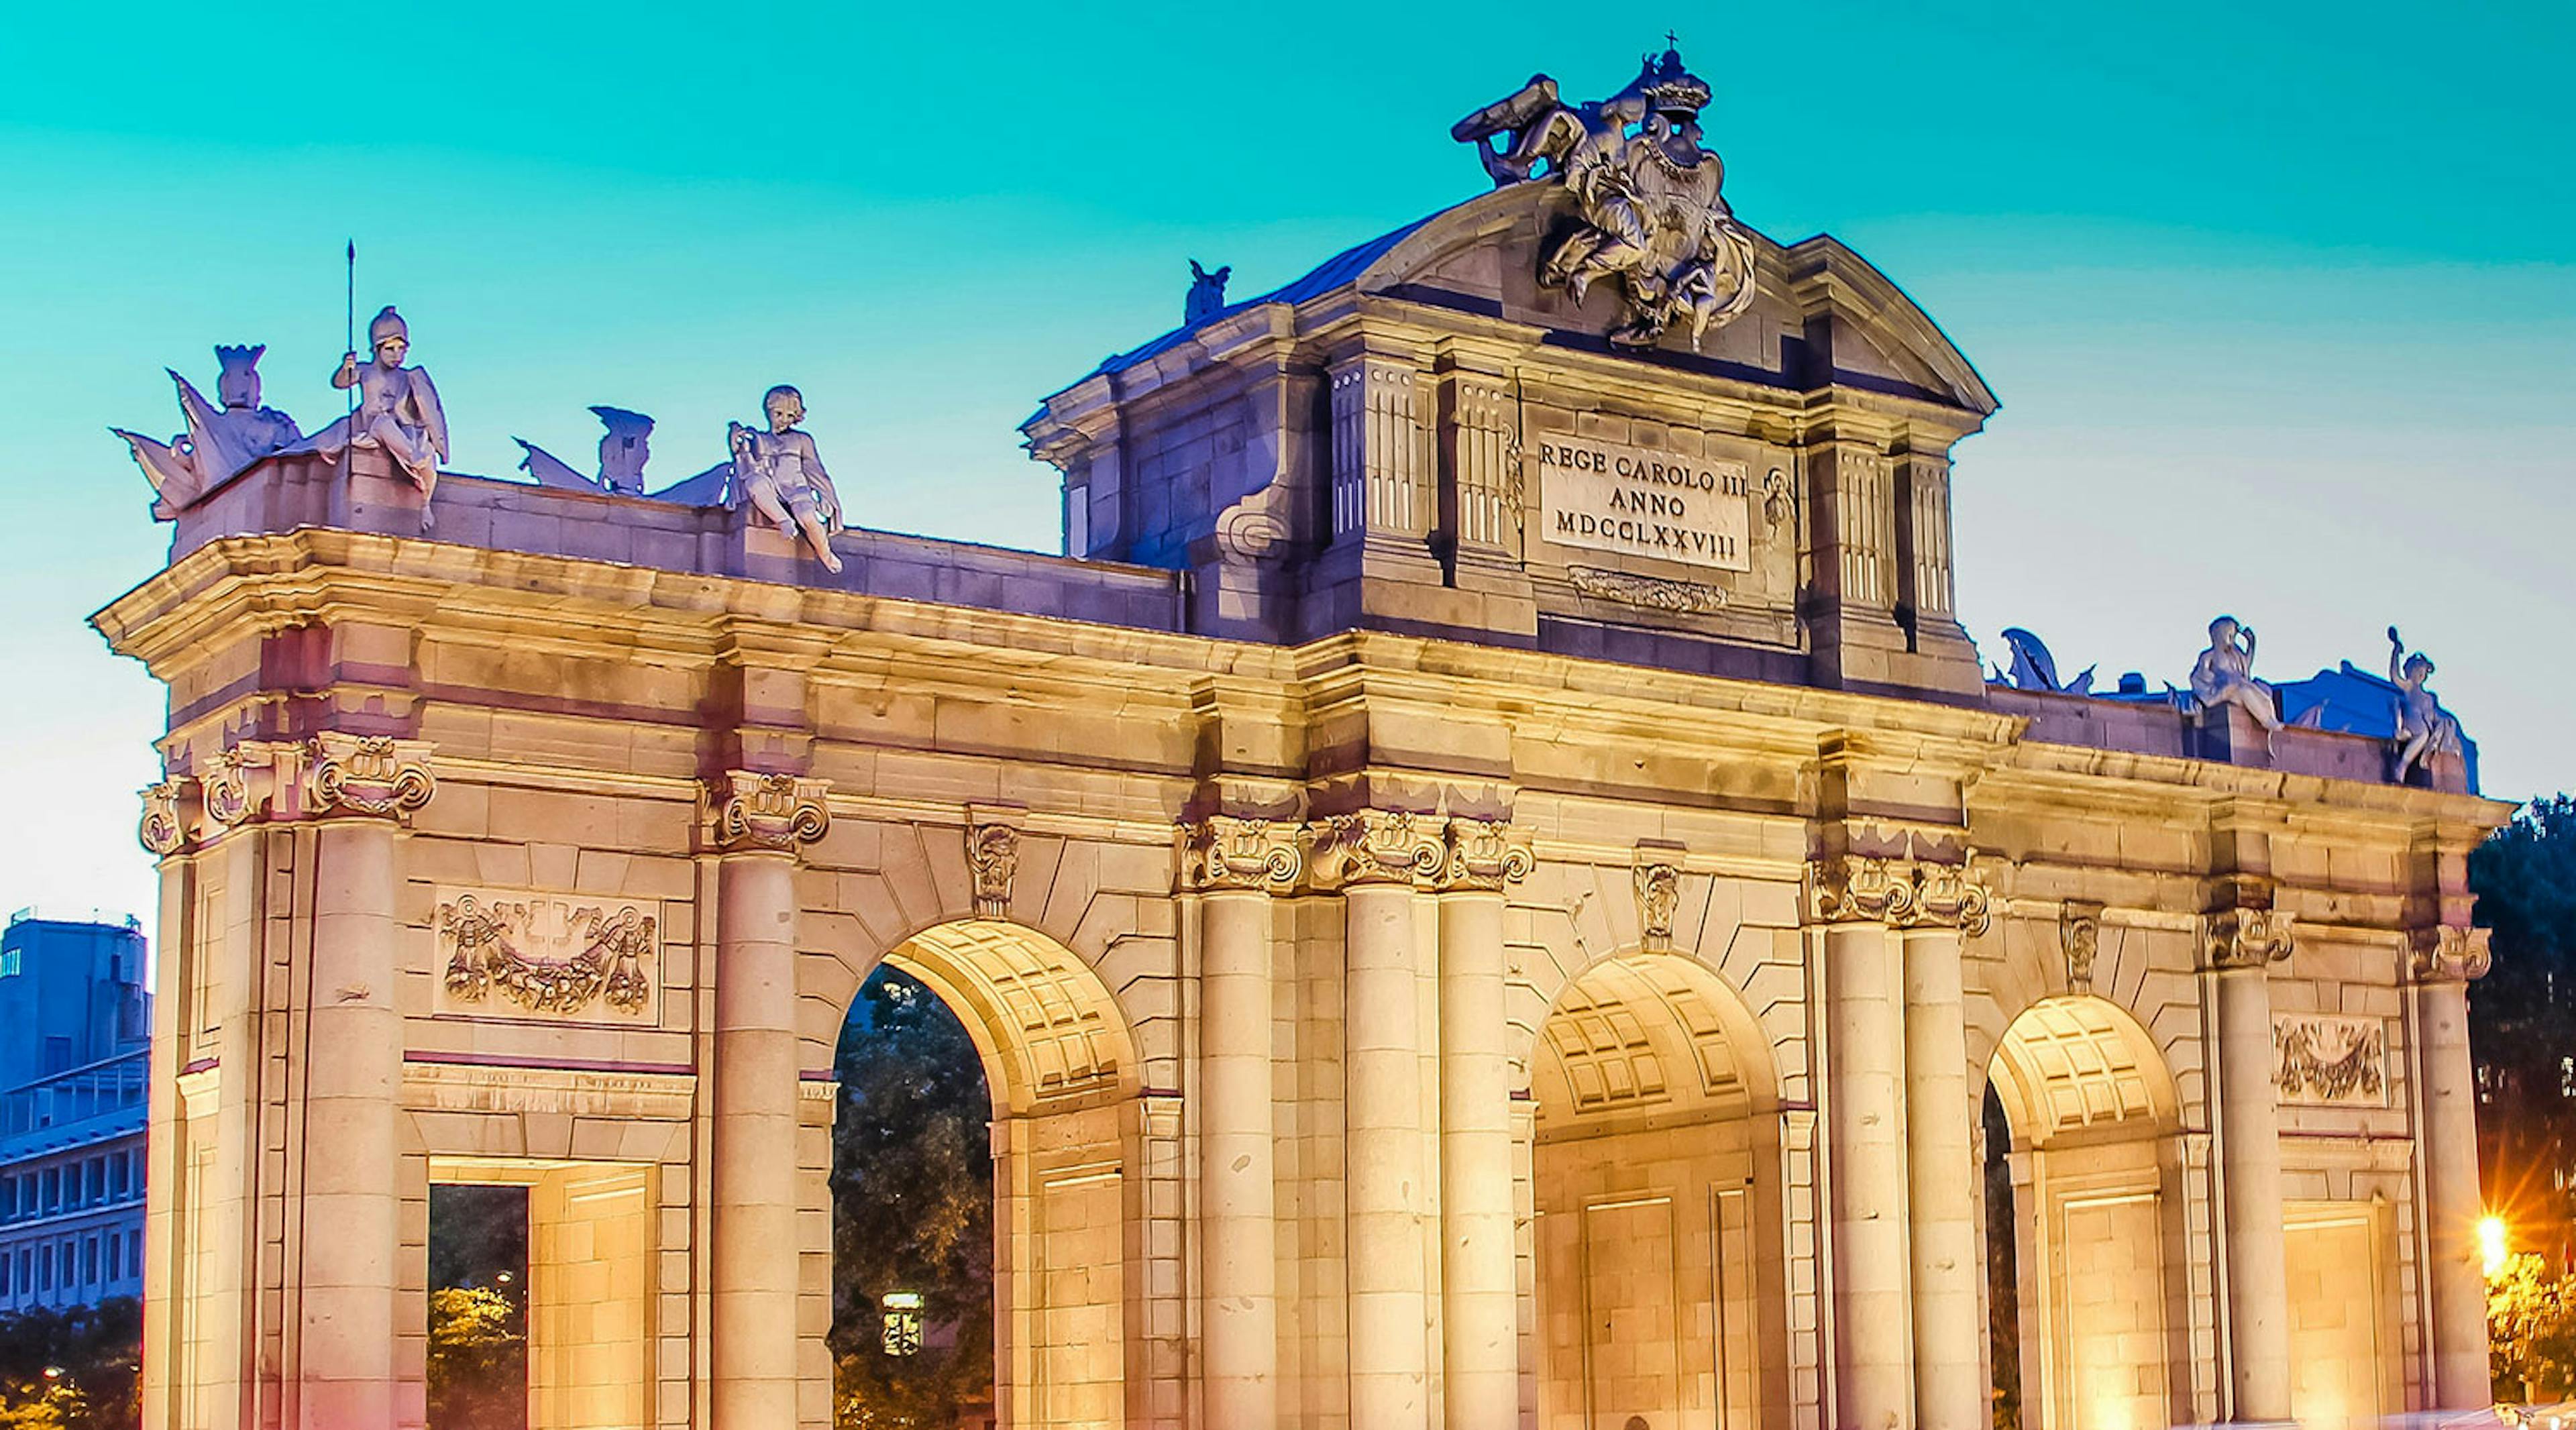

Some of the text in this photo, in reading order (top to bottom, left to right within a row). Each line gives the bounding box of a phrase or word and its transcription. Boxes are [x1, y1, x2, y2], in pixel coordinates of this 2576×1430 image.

[1540, 443, 1747, 498] REGE CAROLO III
[1610, 488, 1684, 516] ANNO
[1556, 510, 1735, 557] MDCCLXXVIII
